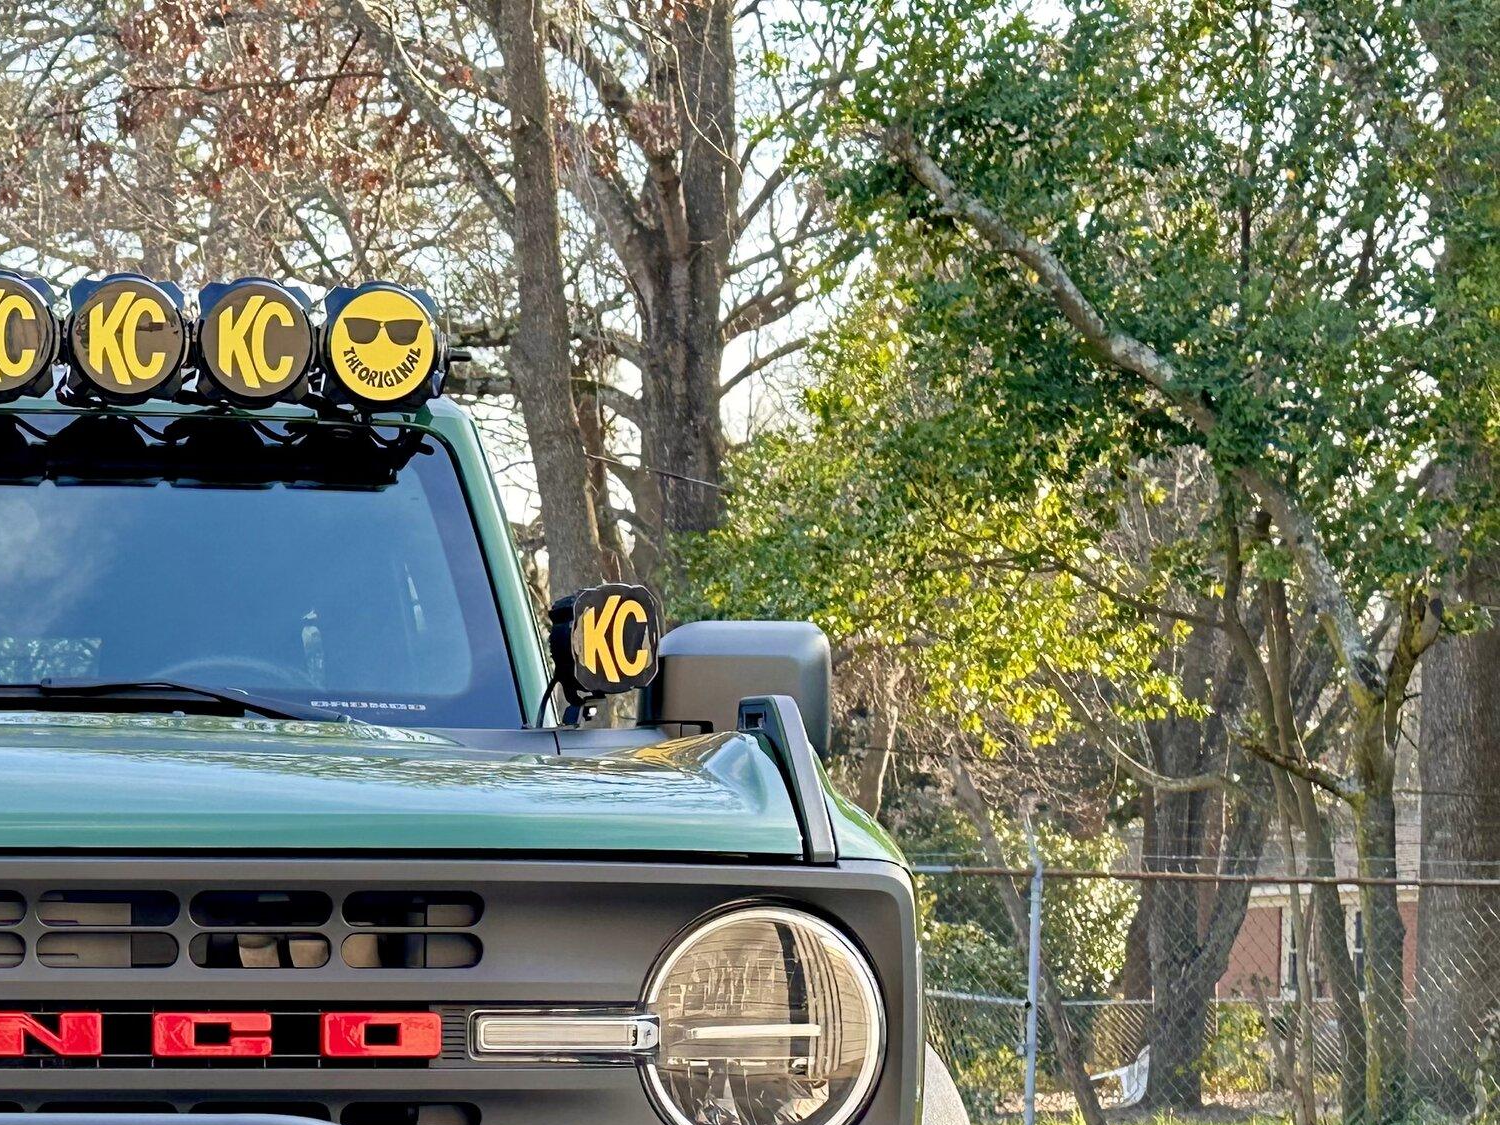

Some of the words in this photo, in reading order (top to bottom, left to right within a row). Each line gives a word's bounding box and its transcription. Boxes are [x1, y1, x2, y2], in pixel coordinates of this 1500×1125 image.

[88, 291, 166, 386] KC
[217, 295, 295, 388] KC
[343, 346, 363, 374] THE
[357, 348, 421, 388] ORIGINAL
[582, 595, 649, 683] KC
